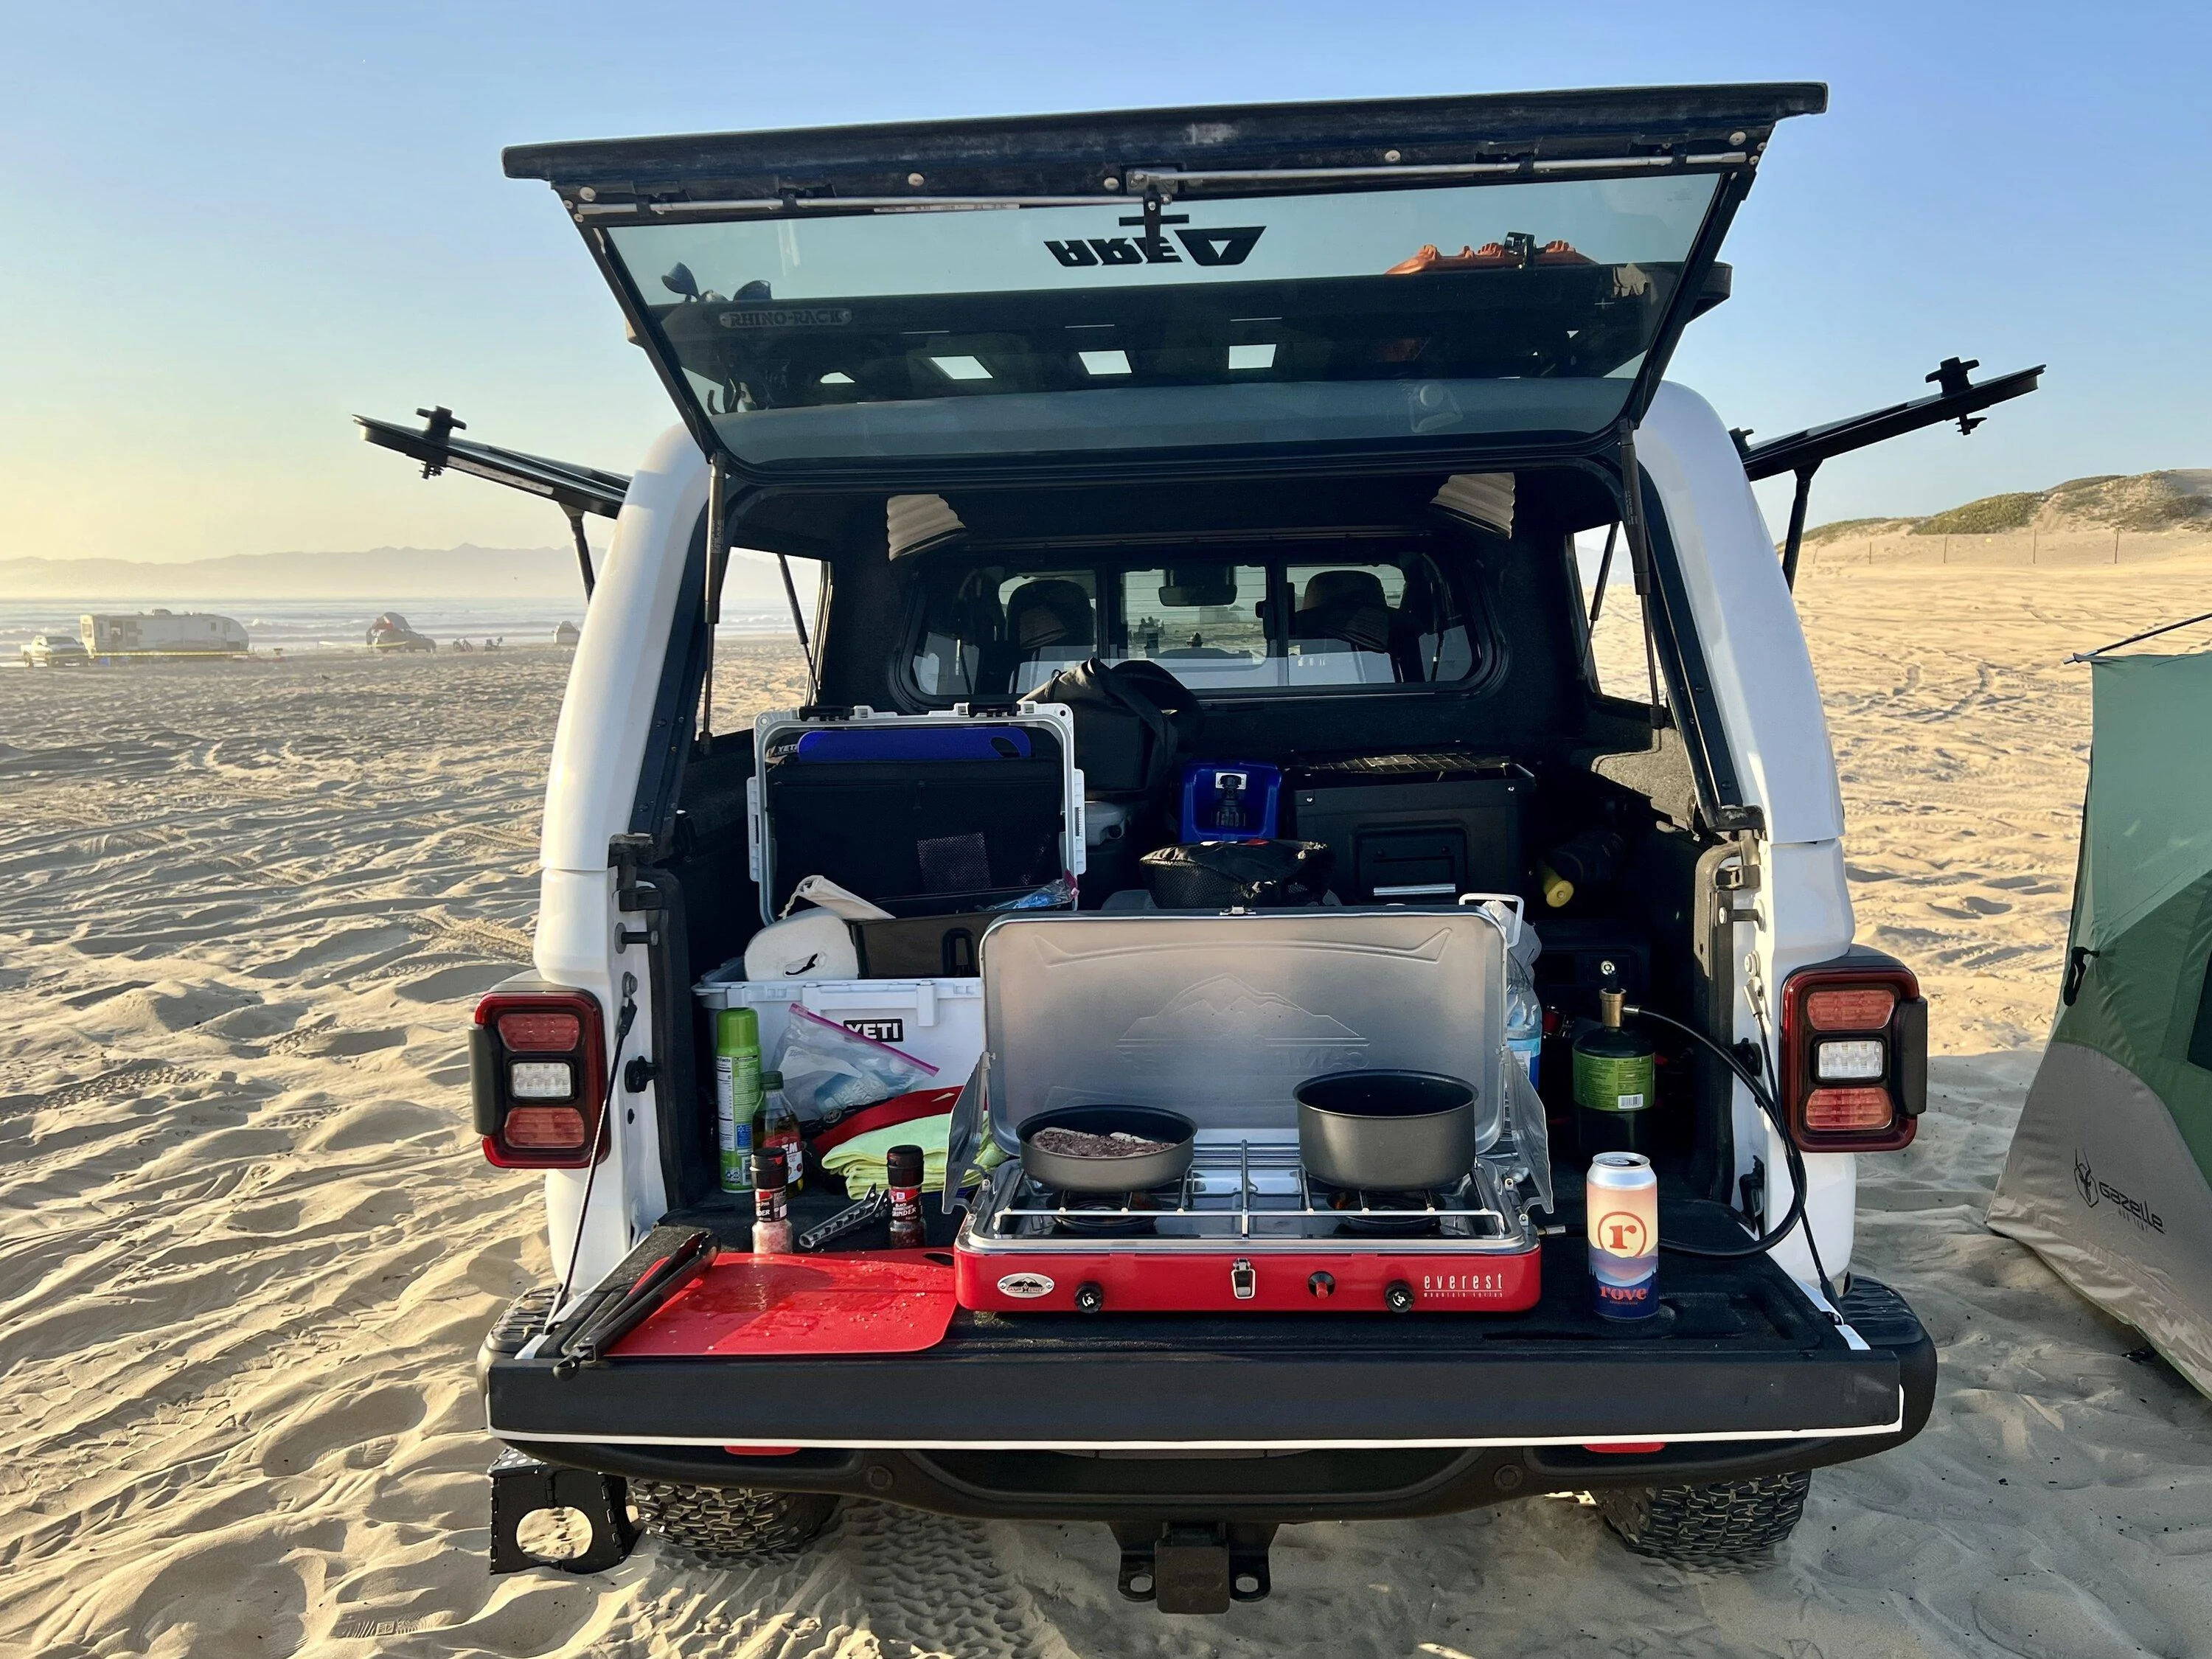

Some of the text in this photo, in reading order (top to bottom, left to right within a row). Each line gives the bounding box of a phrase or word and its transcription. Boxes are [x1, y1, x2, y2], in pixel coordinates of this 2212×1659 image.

[729, 310, 844, 326] RHINO-RACK
[846, 1023, 899, 1040] YETI
[1609, 1225, 1637, 1250] r
[1424, 1273, 1502, 1290] everest
[1599, 1286, 1647, 1301] rove
